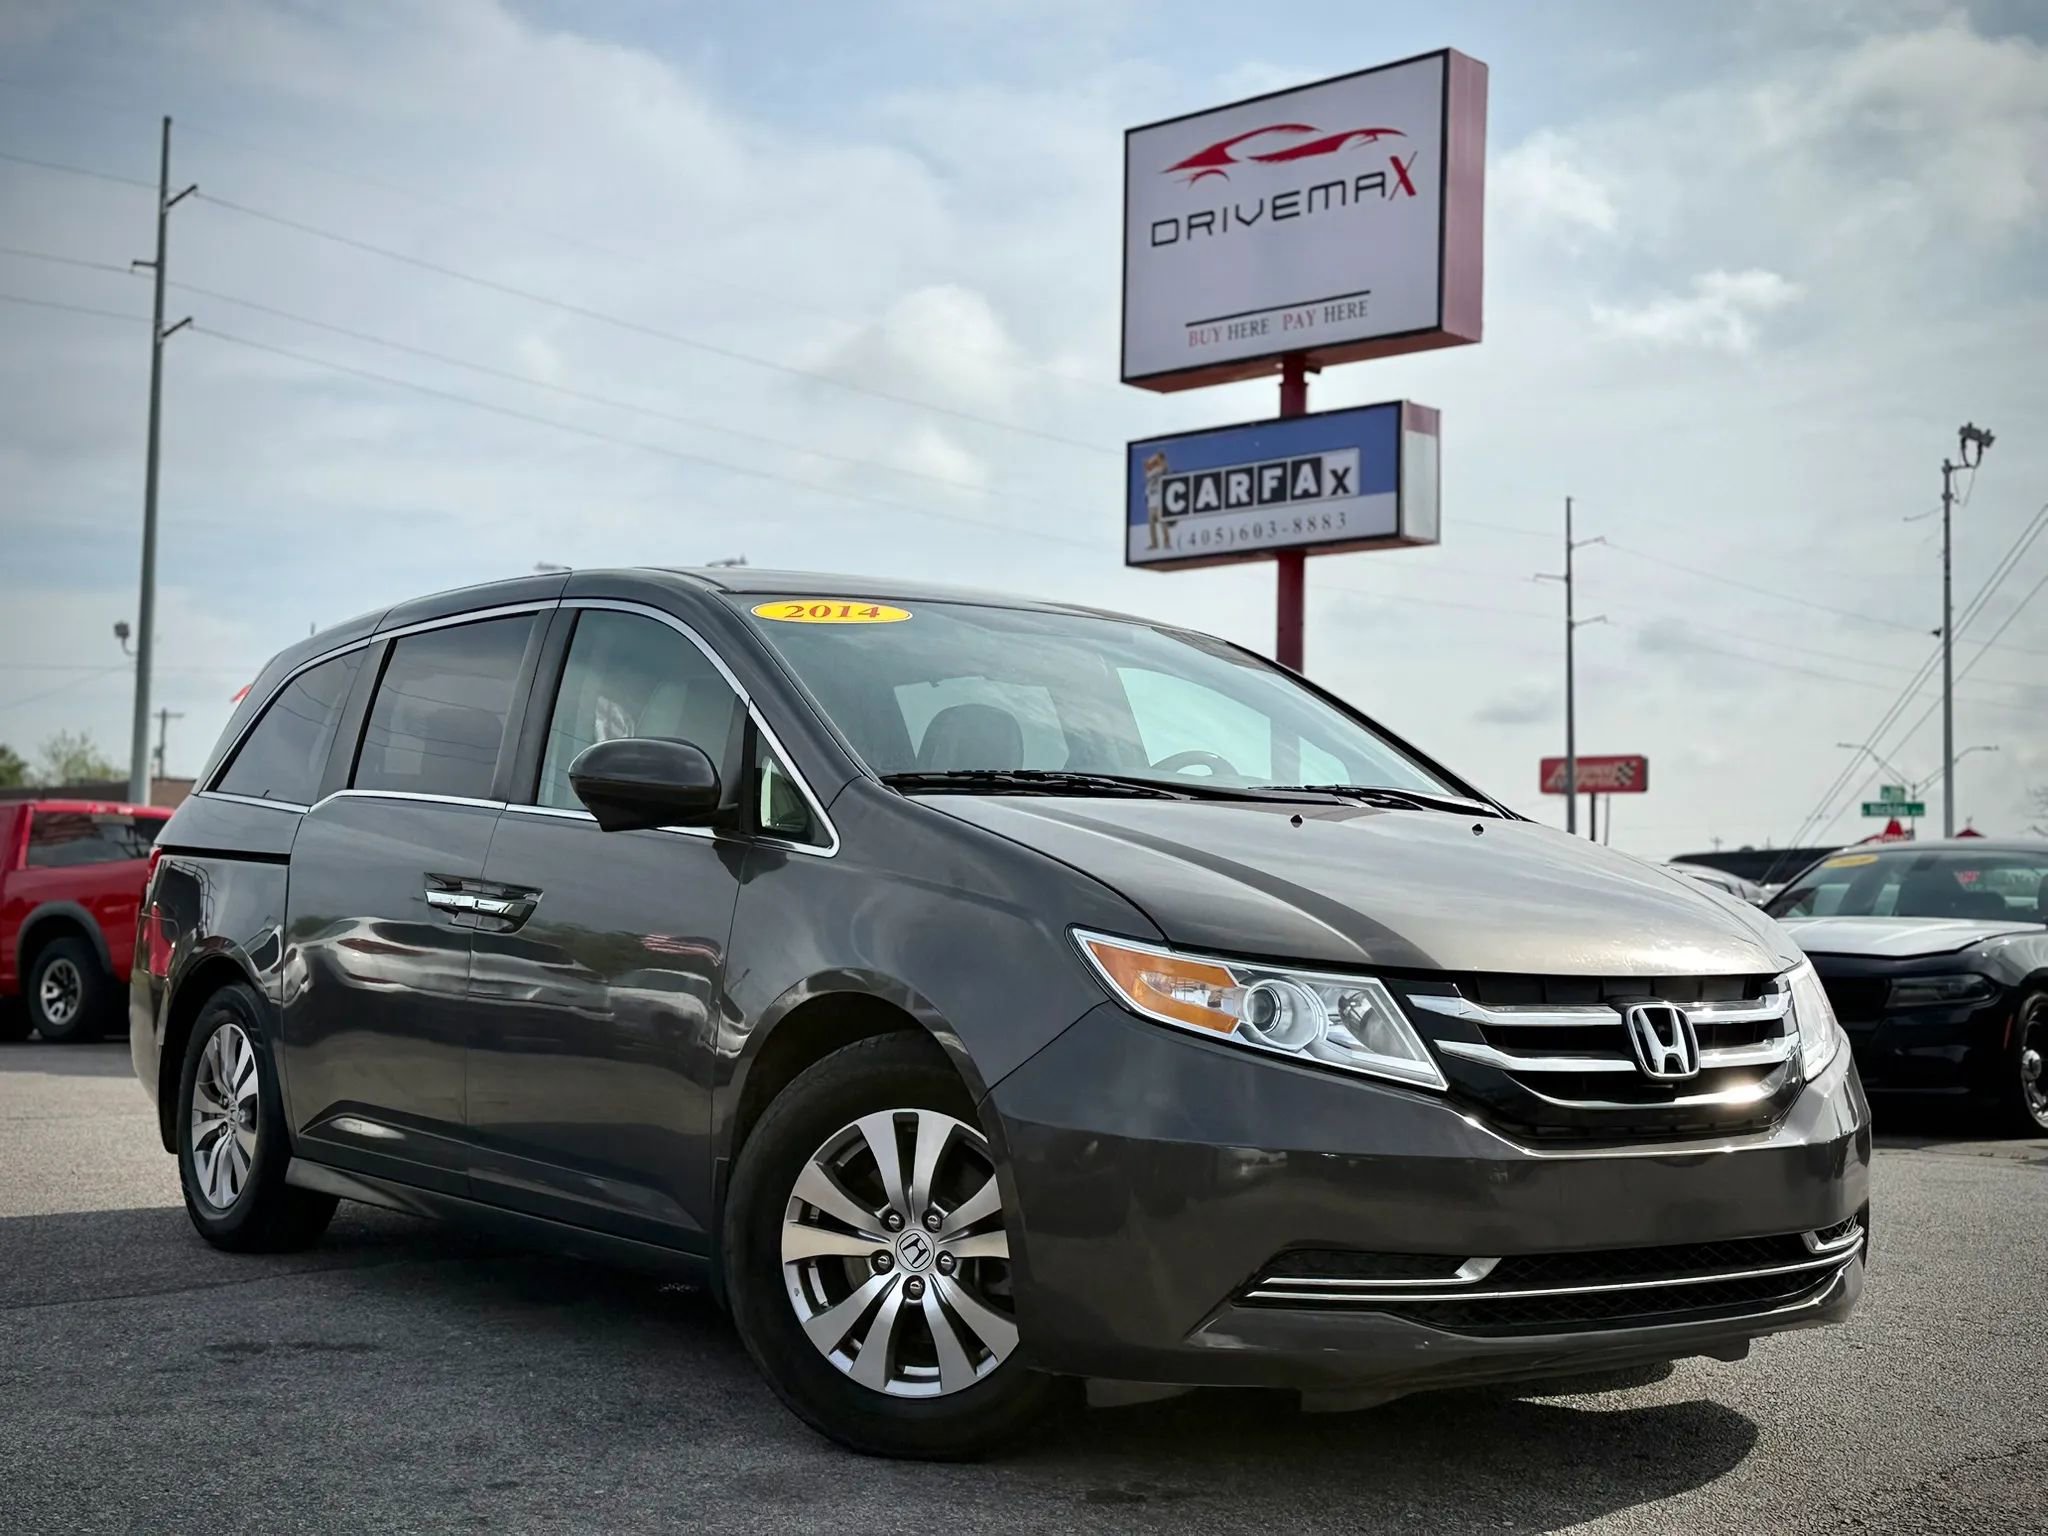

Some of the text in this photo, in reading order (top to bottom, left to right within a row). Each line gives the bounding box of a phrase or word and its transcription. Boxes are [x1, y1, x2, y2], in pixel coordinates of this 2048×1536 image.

[1188, 300, 1369, 348] BUY HERE PAY HERE
[1163, 461, 1353, 515] CARFAX
[1176, 512, 1347, 551] (405)603-8883
[784, 604, 881, 618] 2014
